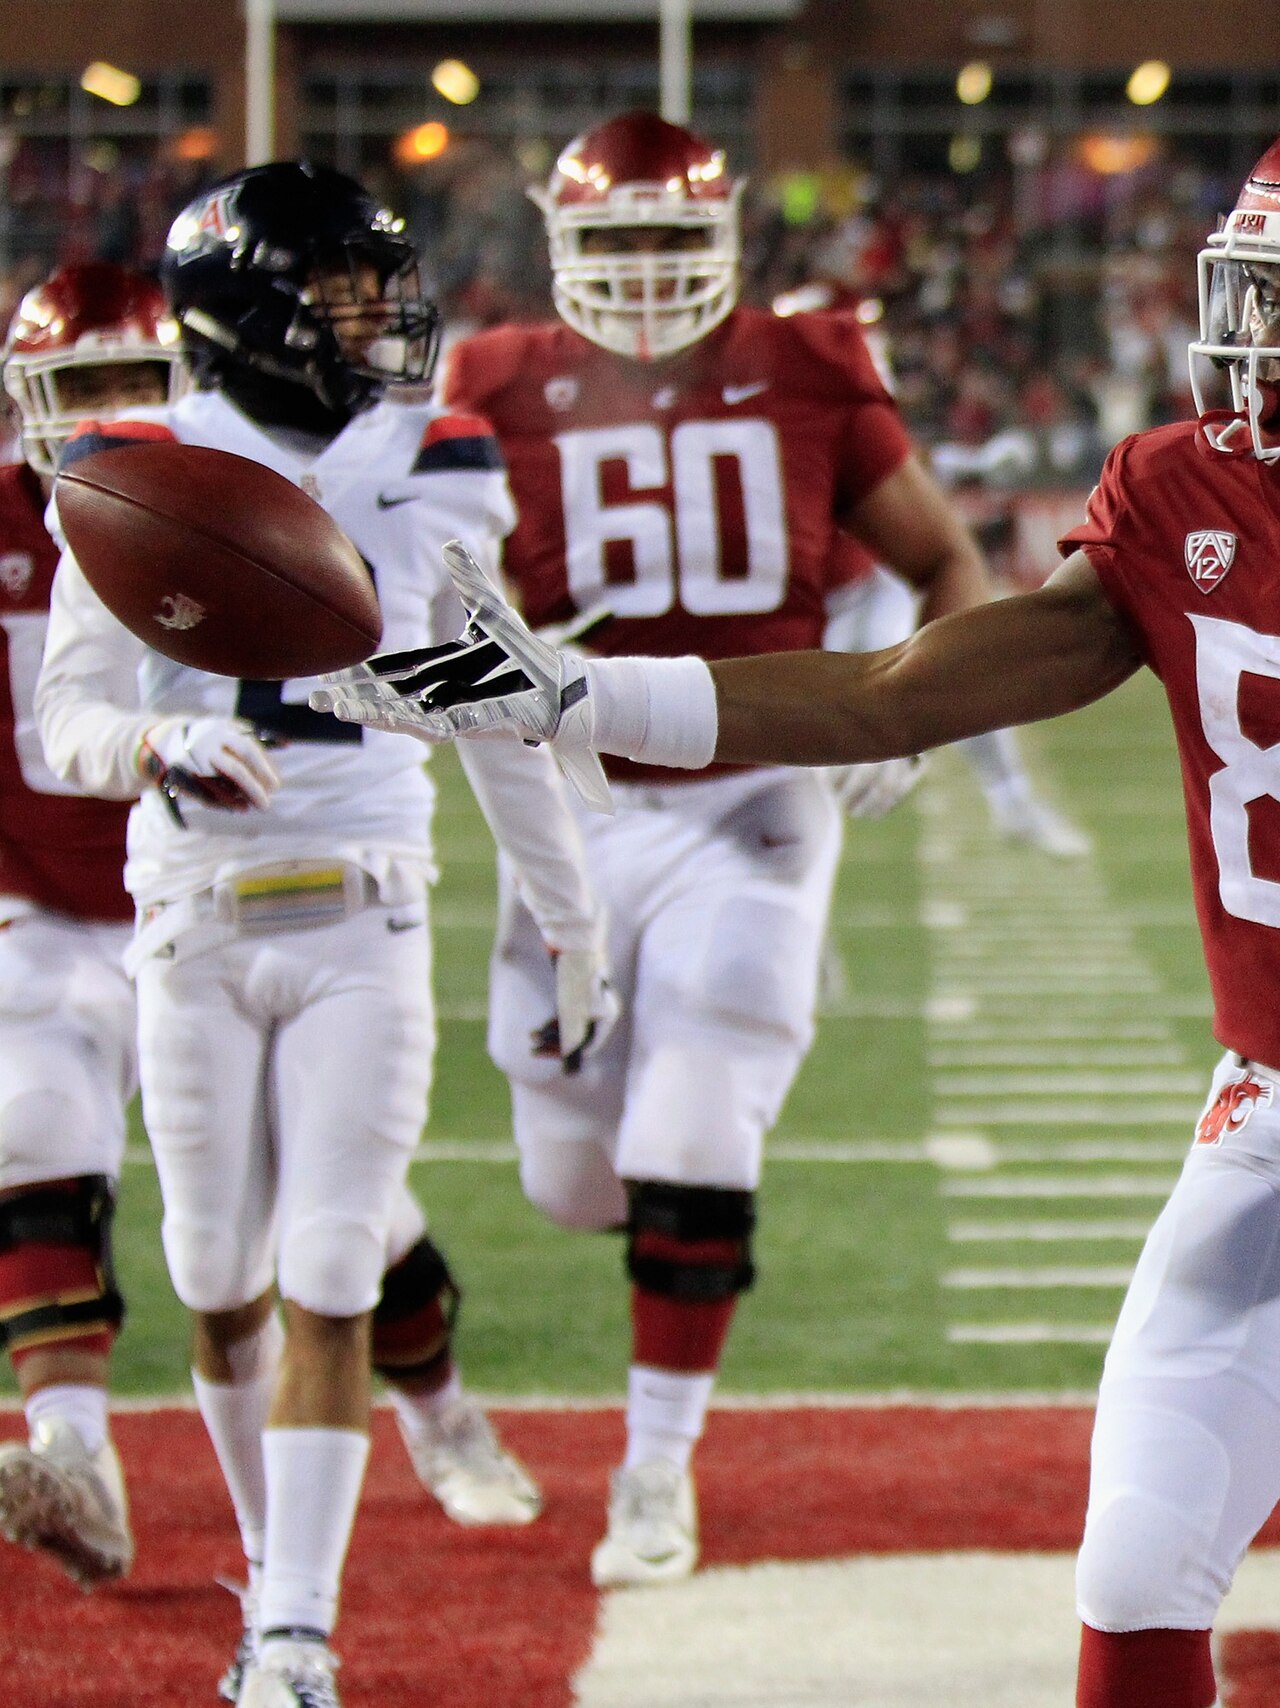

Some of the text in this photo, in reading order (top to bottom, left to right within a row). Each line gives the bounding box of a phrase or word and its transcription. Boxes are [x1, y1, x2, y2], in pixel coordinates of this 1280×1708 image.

[552, 417, 788, 618] 60
[1188, 532, 1233, 568] PAC
[1196, 557, 1220, 580] 12
